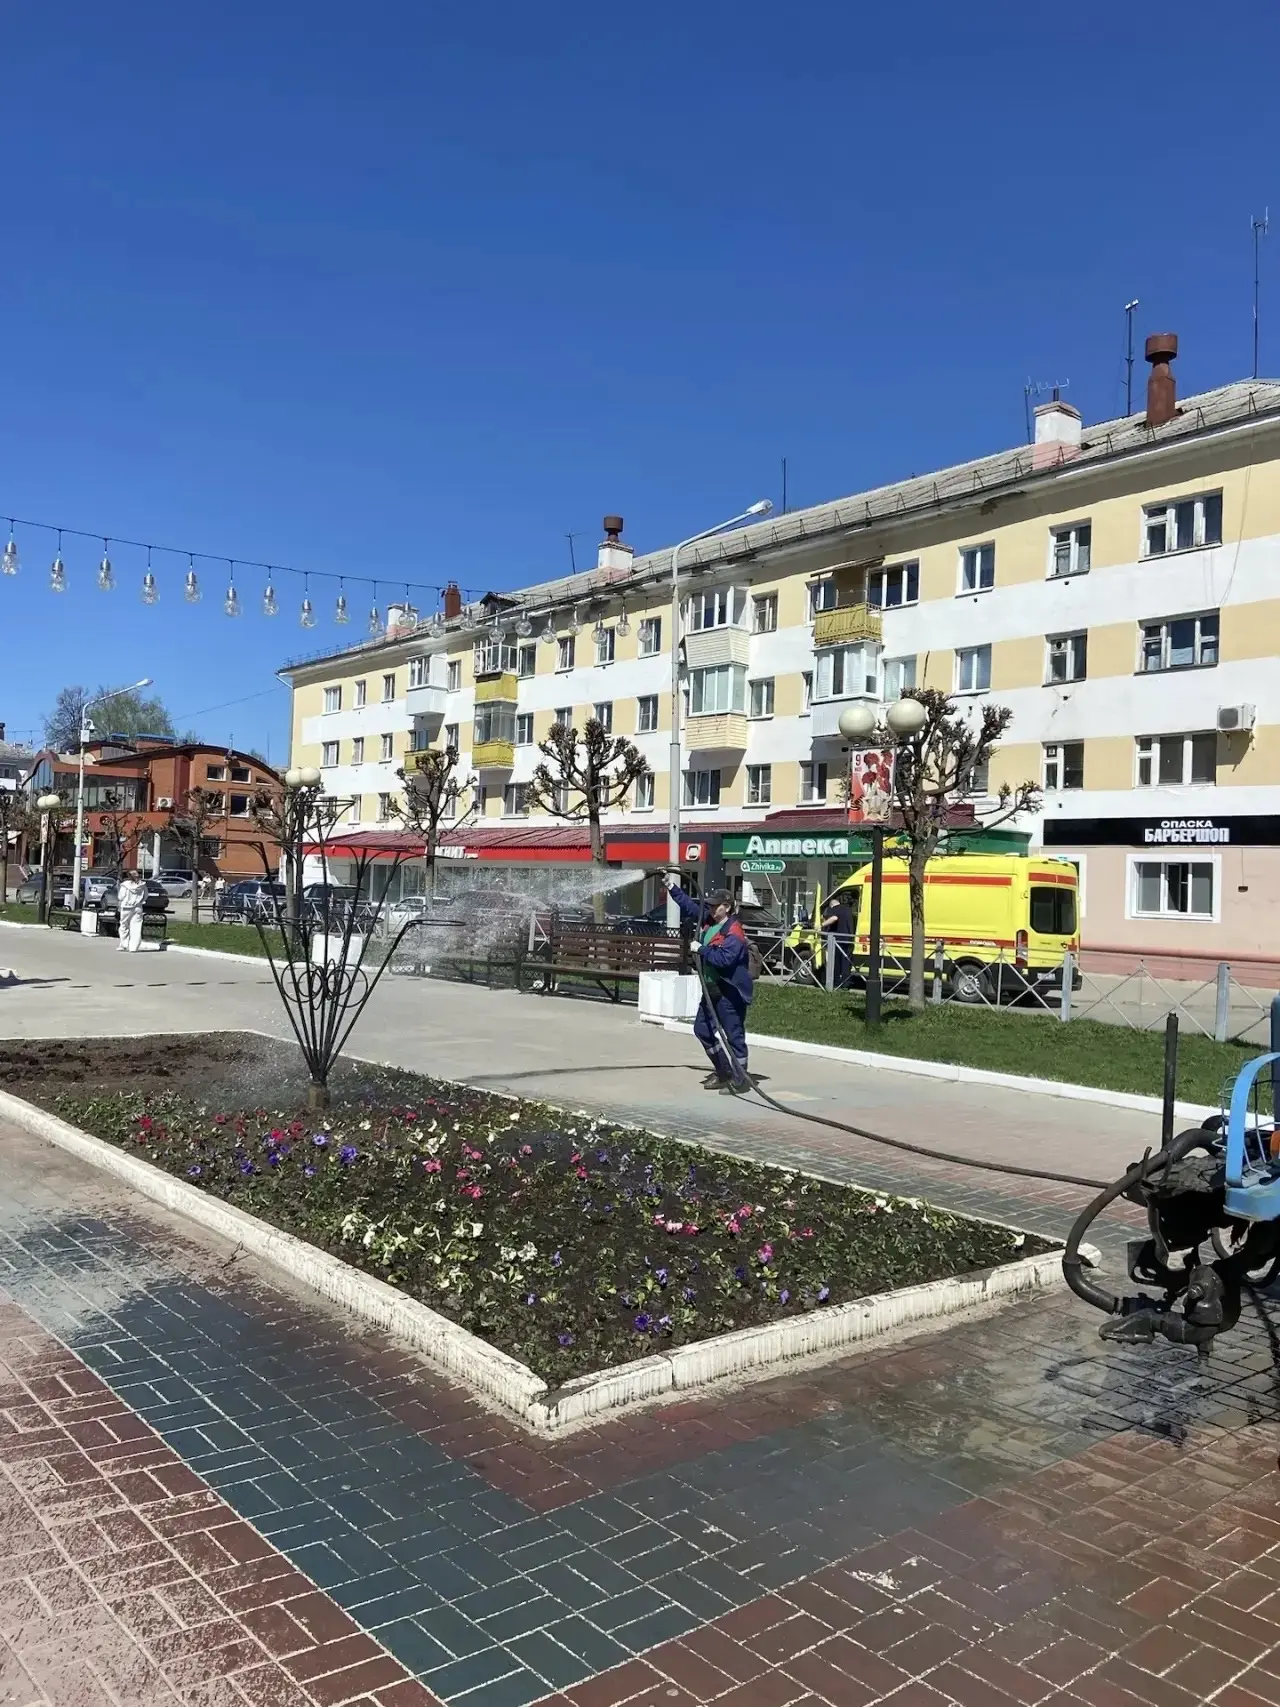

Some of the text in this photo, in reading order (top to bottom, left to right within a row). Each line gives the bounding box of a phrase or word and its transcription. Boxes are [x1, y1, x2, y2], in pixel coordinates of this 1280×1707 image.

[855, 754, 861, 766] 9
[1160, 820, 1213, 828] ОПАСКА
[1144, 828, 1230, 843] БАРБЕРШОП
[745, 835, 849, 856] Аптека
